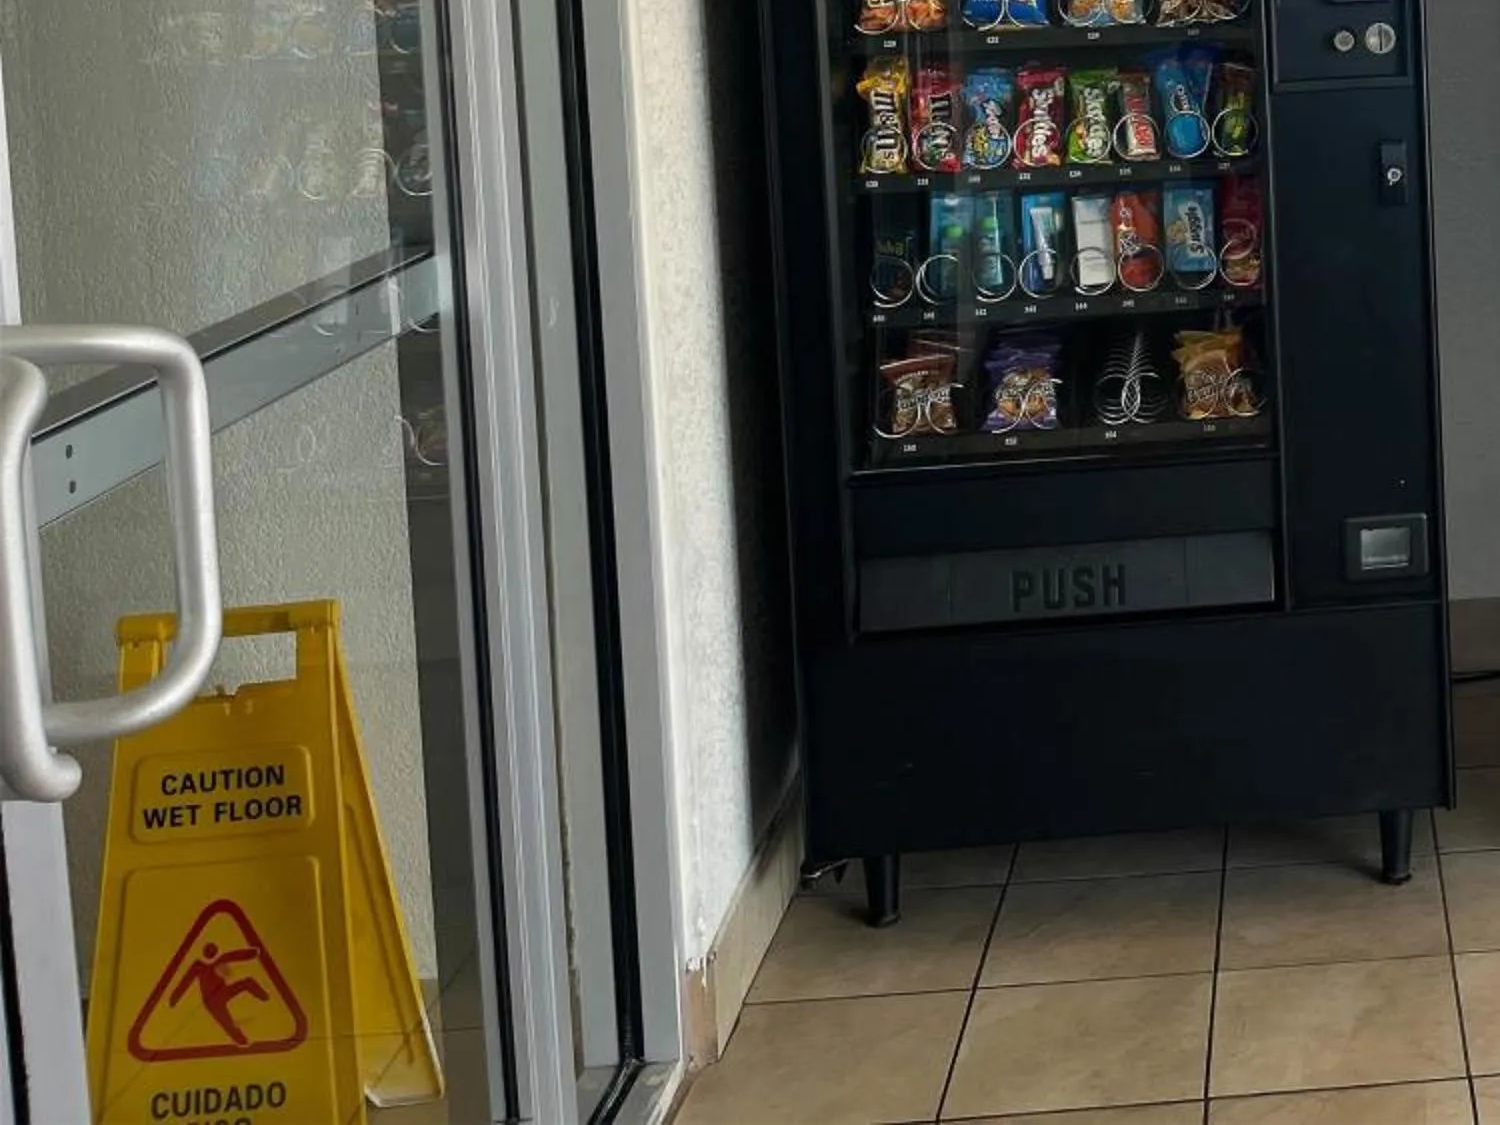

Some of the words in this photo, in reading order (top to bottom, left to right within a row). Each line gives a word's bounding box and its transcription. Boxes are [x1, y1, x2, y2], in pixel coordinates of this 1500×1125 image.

[1012, 564, 1126, 612] PUSH
[161, 764, 284, 796] CAUTION
[142, 804, 202, 830] WET
[214, 794, 303, 823] FLOOR
[151, 1081, 287, 1120] CUIDADO
